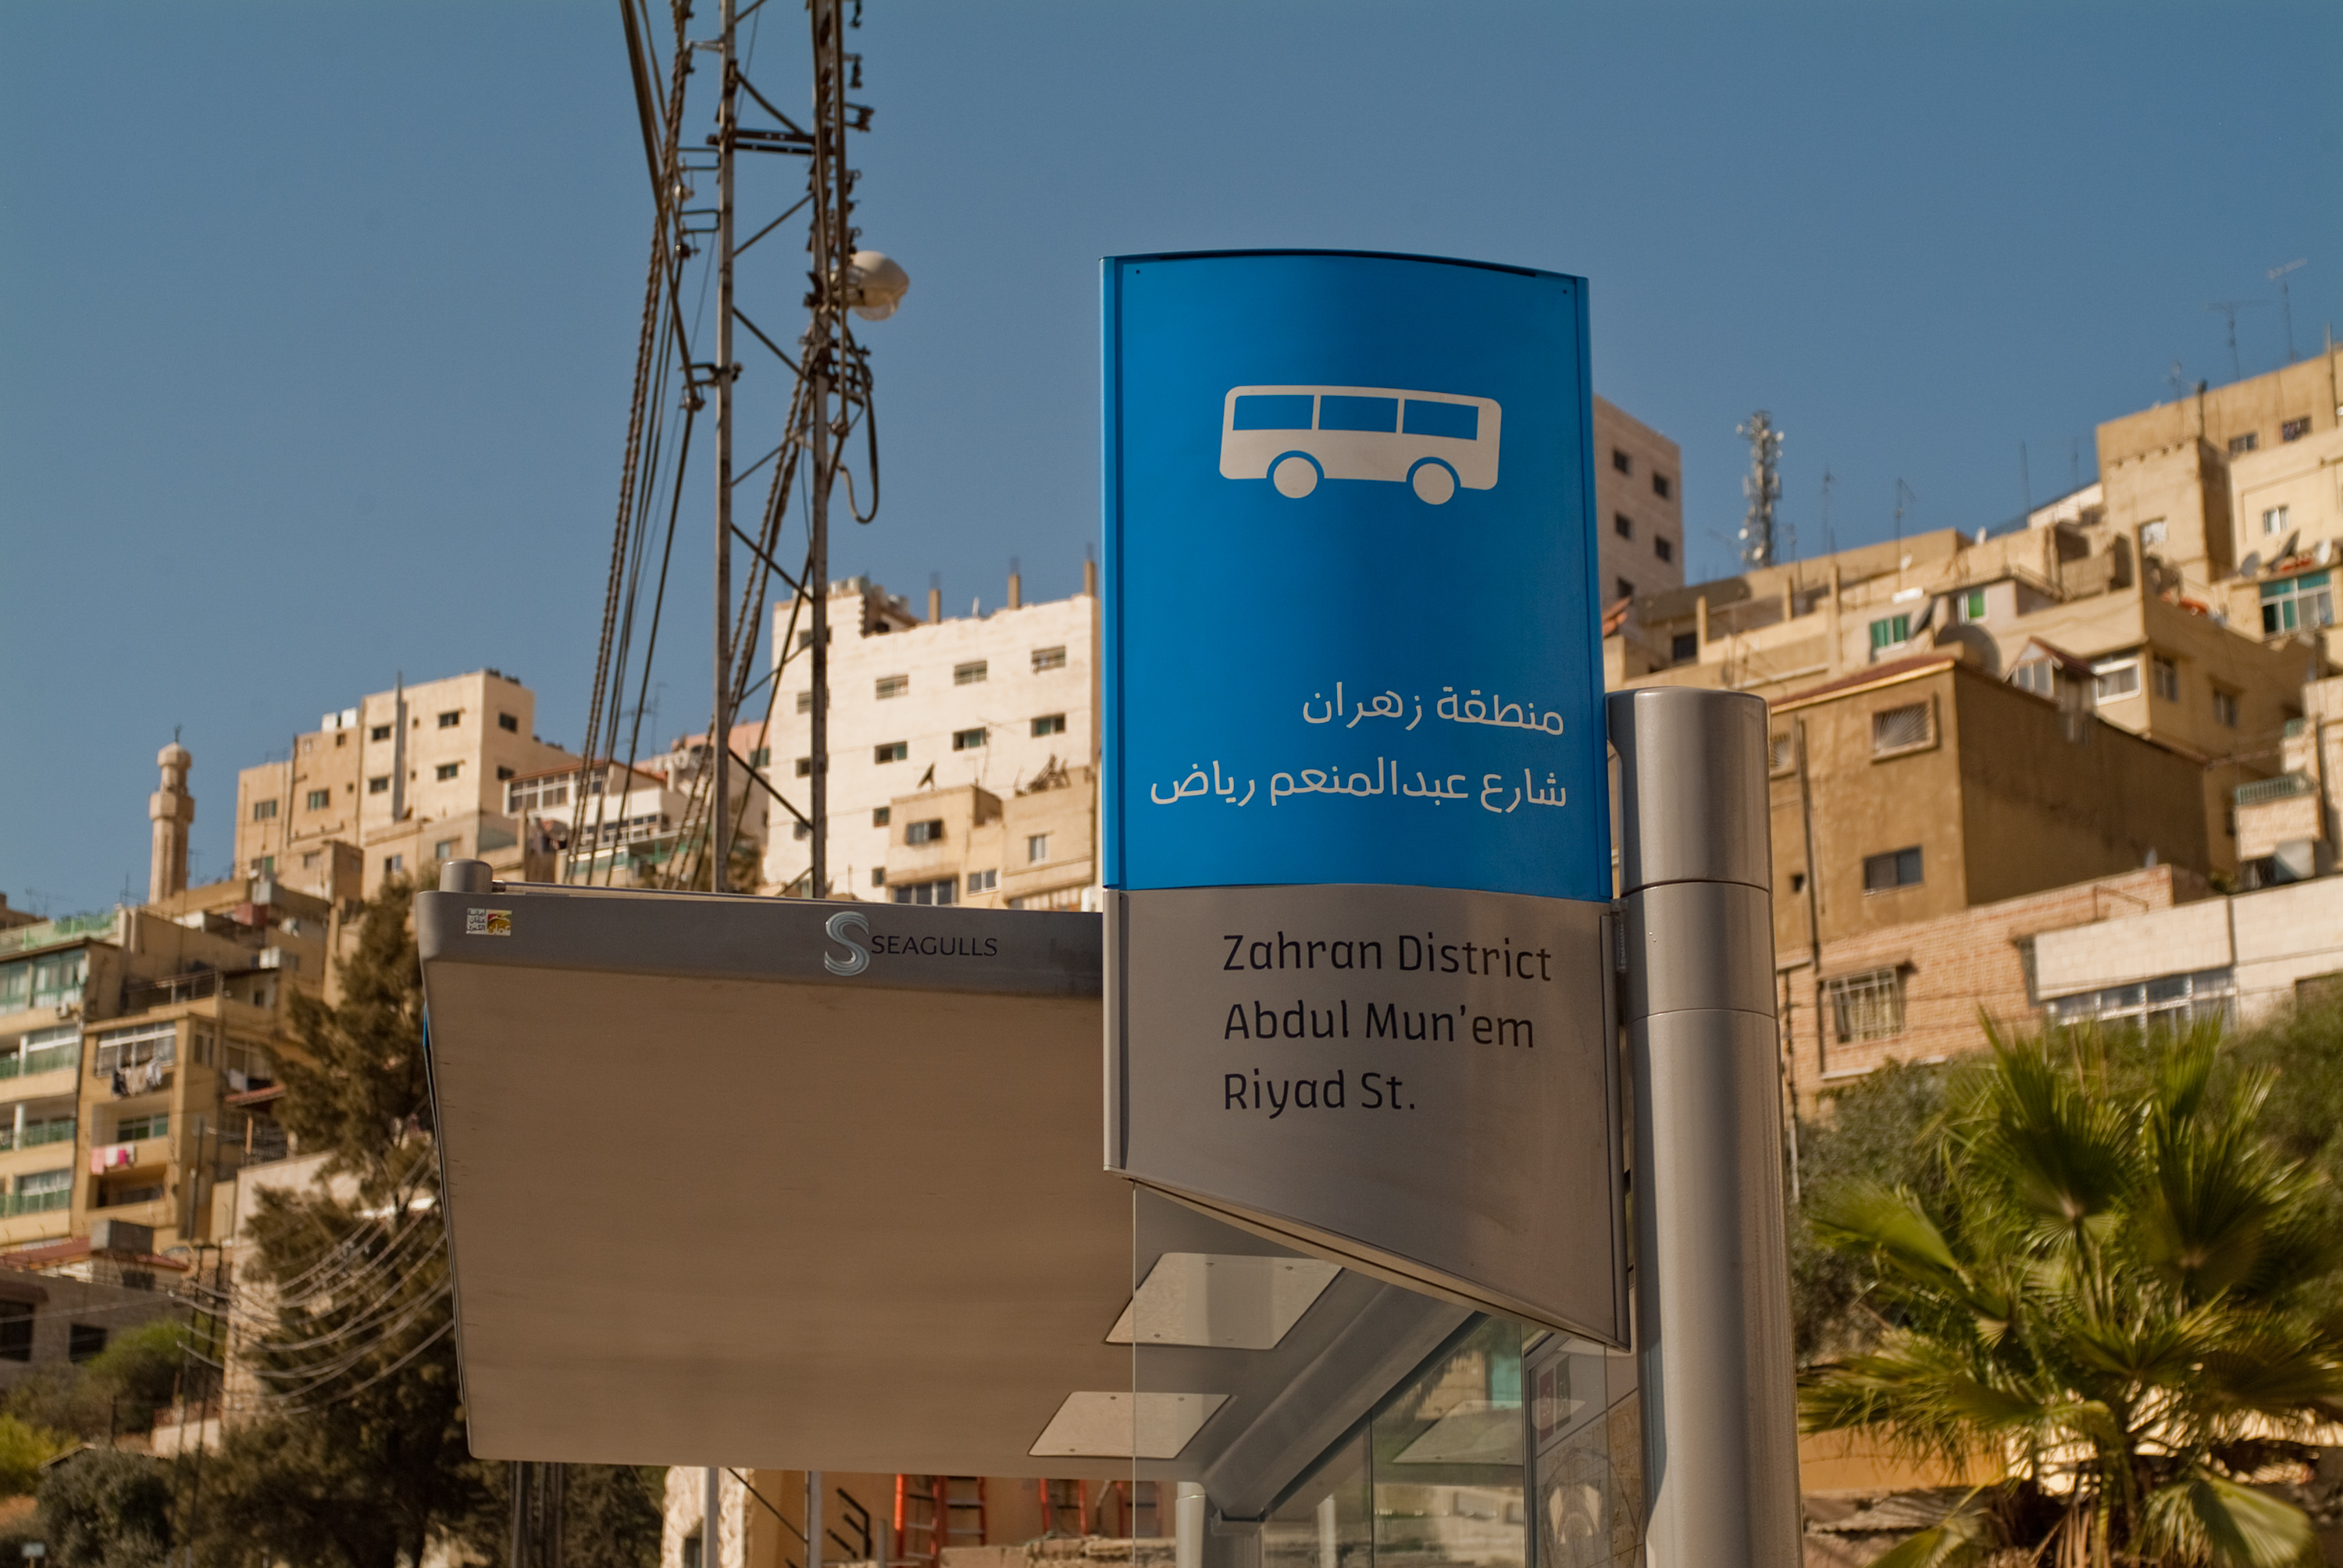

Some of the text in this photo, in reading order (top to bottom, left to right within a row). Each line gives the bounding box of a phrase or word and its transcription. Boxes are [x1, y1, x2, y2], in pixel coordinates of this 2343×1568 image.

[1302, 681, 1564, 736] منطقة زهران
[1150, 759, 1256, 807] رياض
[1480, 768, 1567, 814] شارع
[871, 935, 998, 957] SEAGULLS
[1223, 930, 1552, 982] Zahran District
[1224, 999, 1350, 1040] Abdul
[1224, 1067, 1415, 1120] Riyad St.
